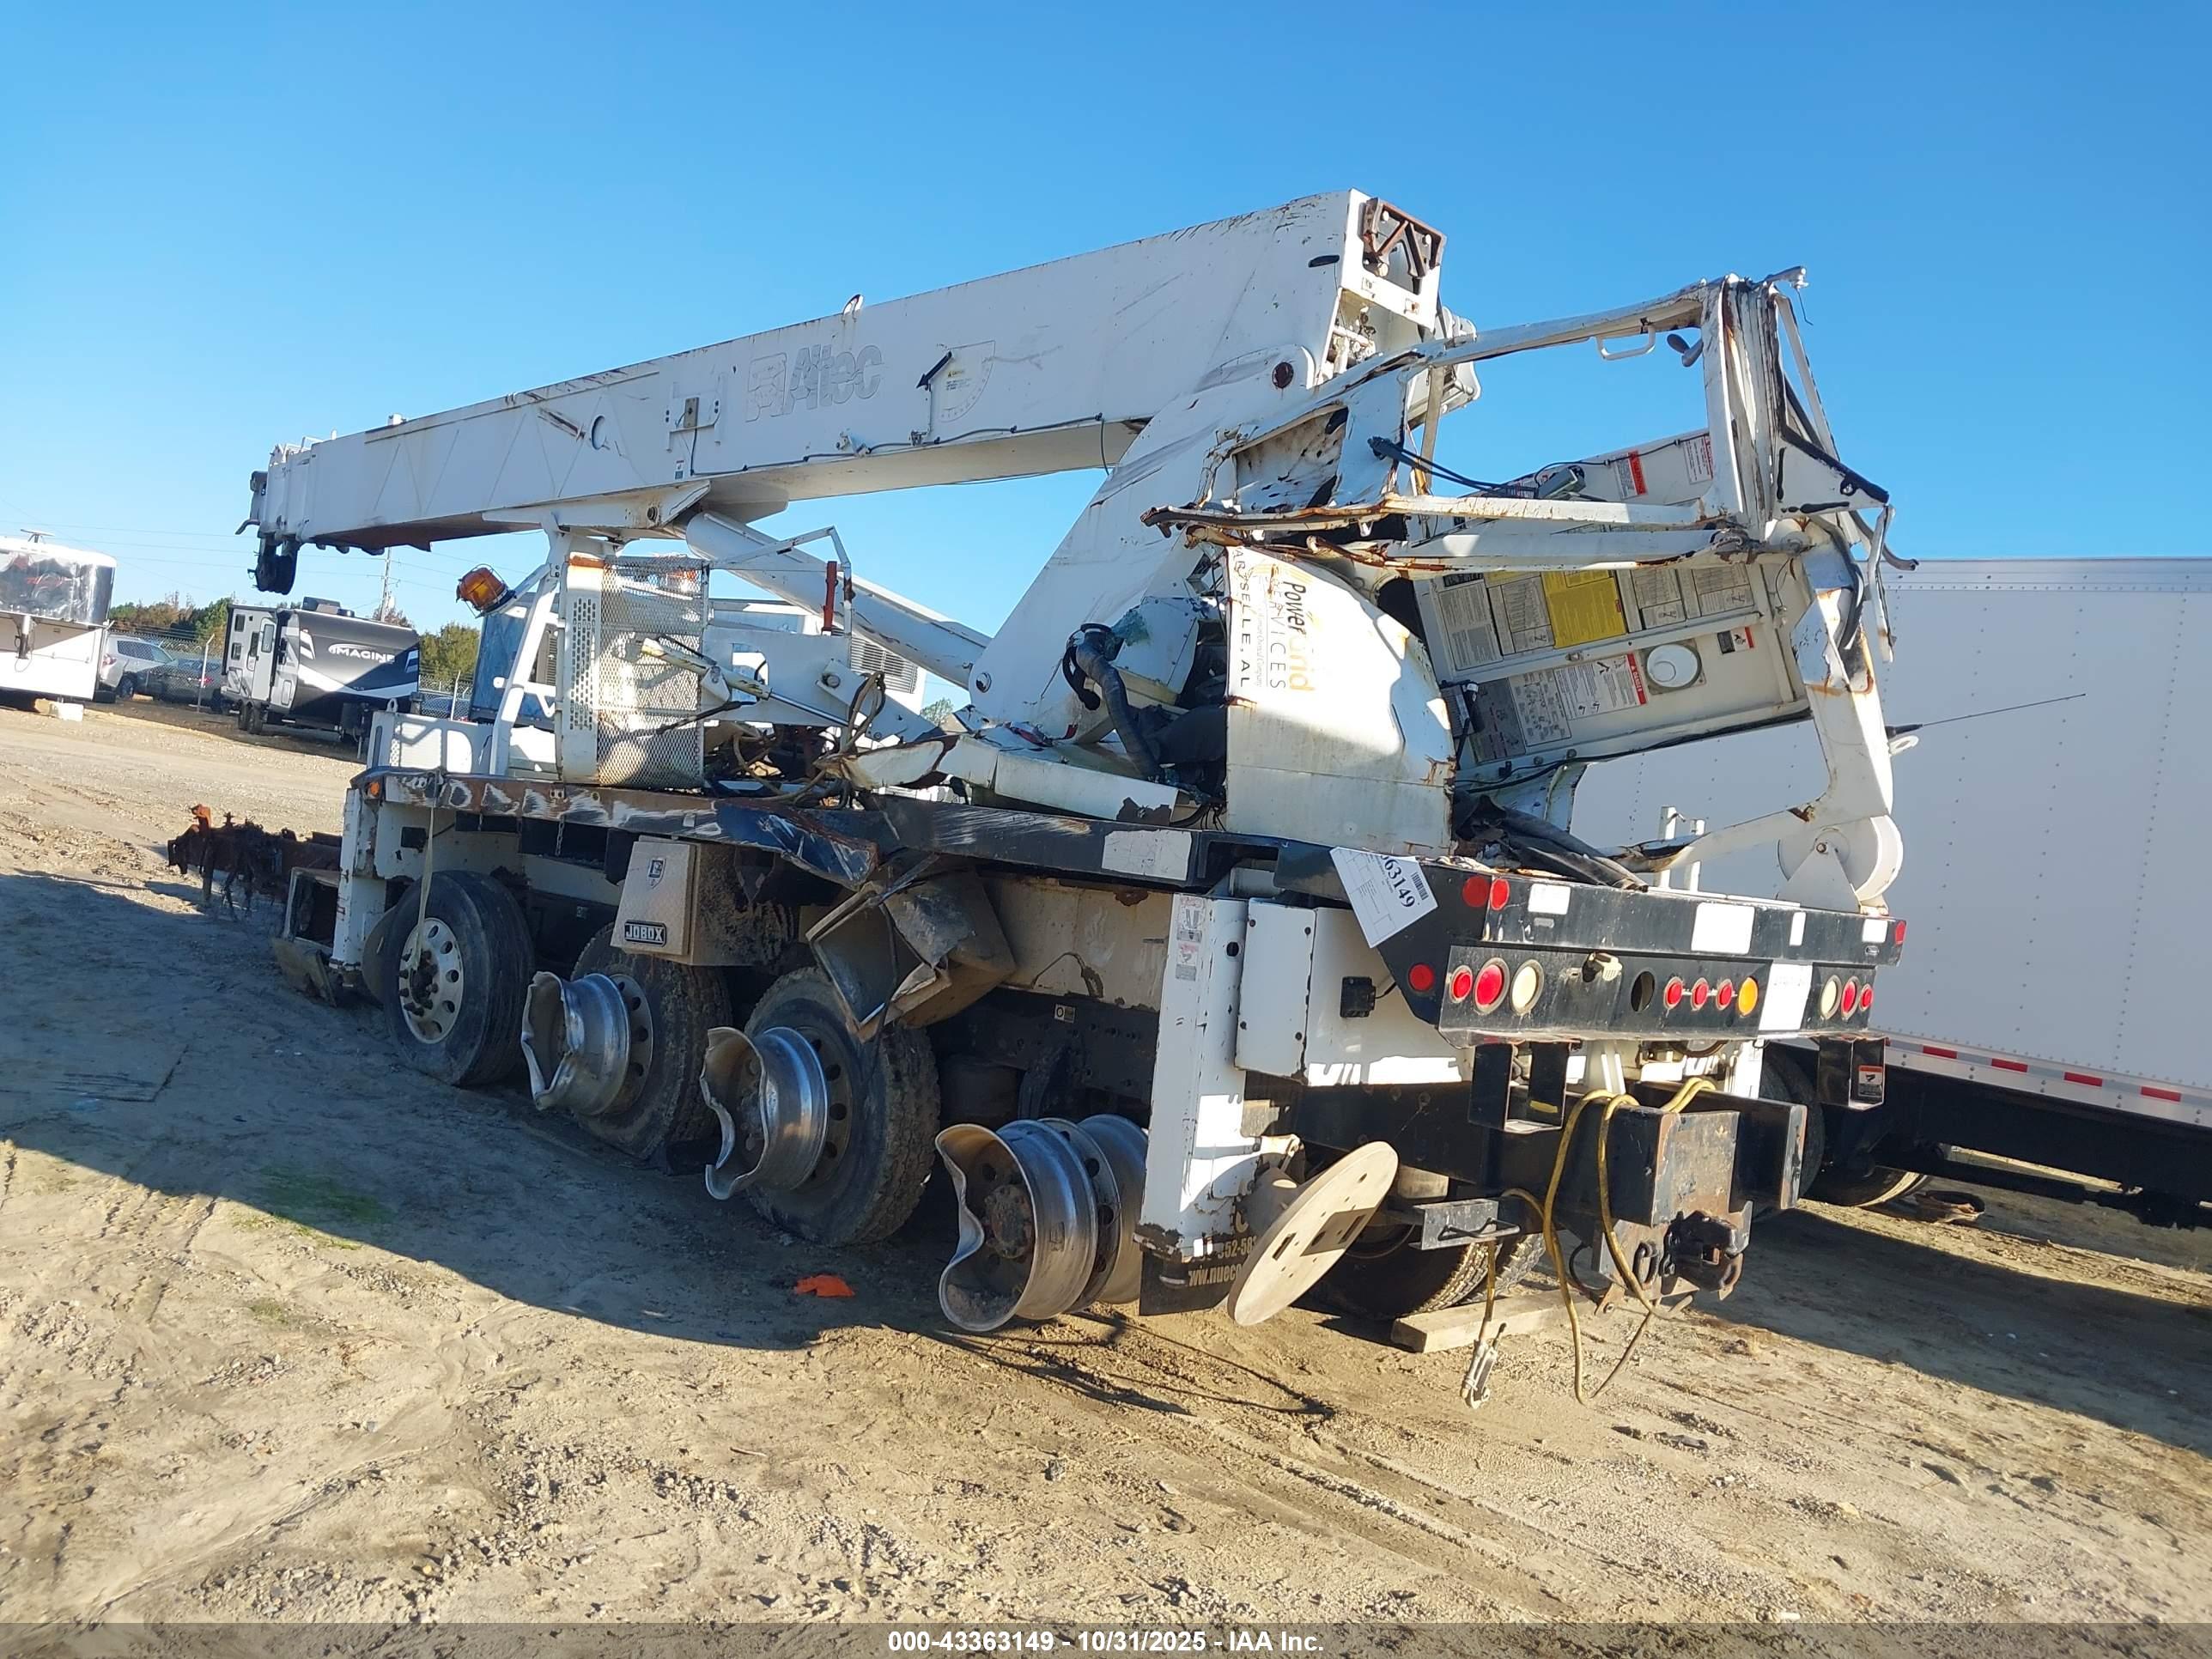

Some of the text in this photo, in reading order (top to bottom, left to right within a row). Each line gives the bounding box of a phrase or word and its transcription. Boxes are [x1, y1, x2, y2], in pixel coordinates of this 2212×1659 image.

[329, 644, 395, 665] IMAGINE
[1240, 659, 1251, 688] AL
[626, 925, 663, 941] JOBOX
